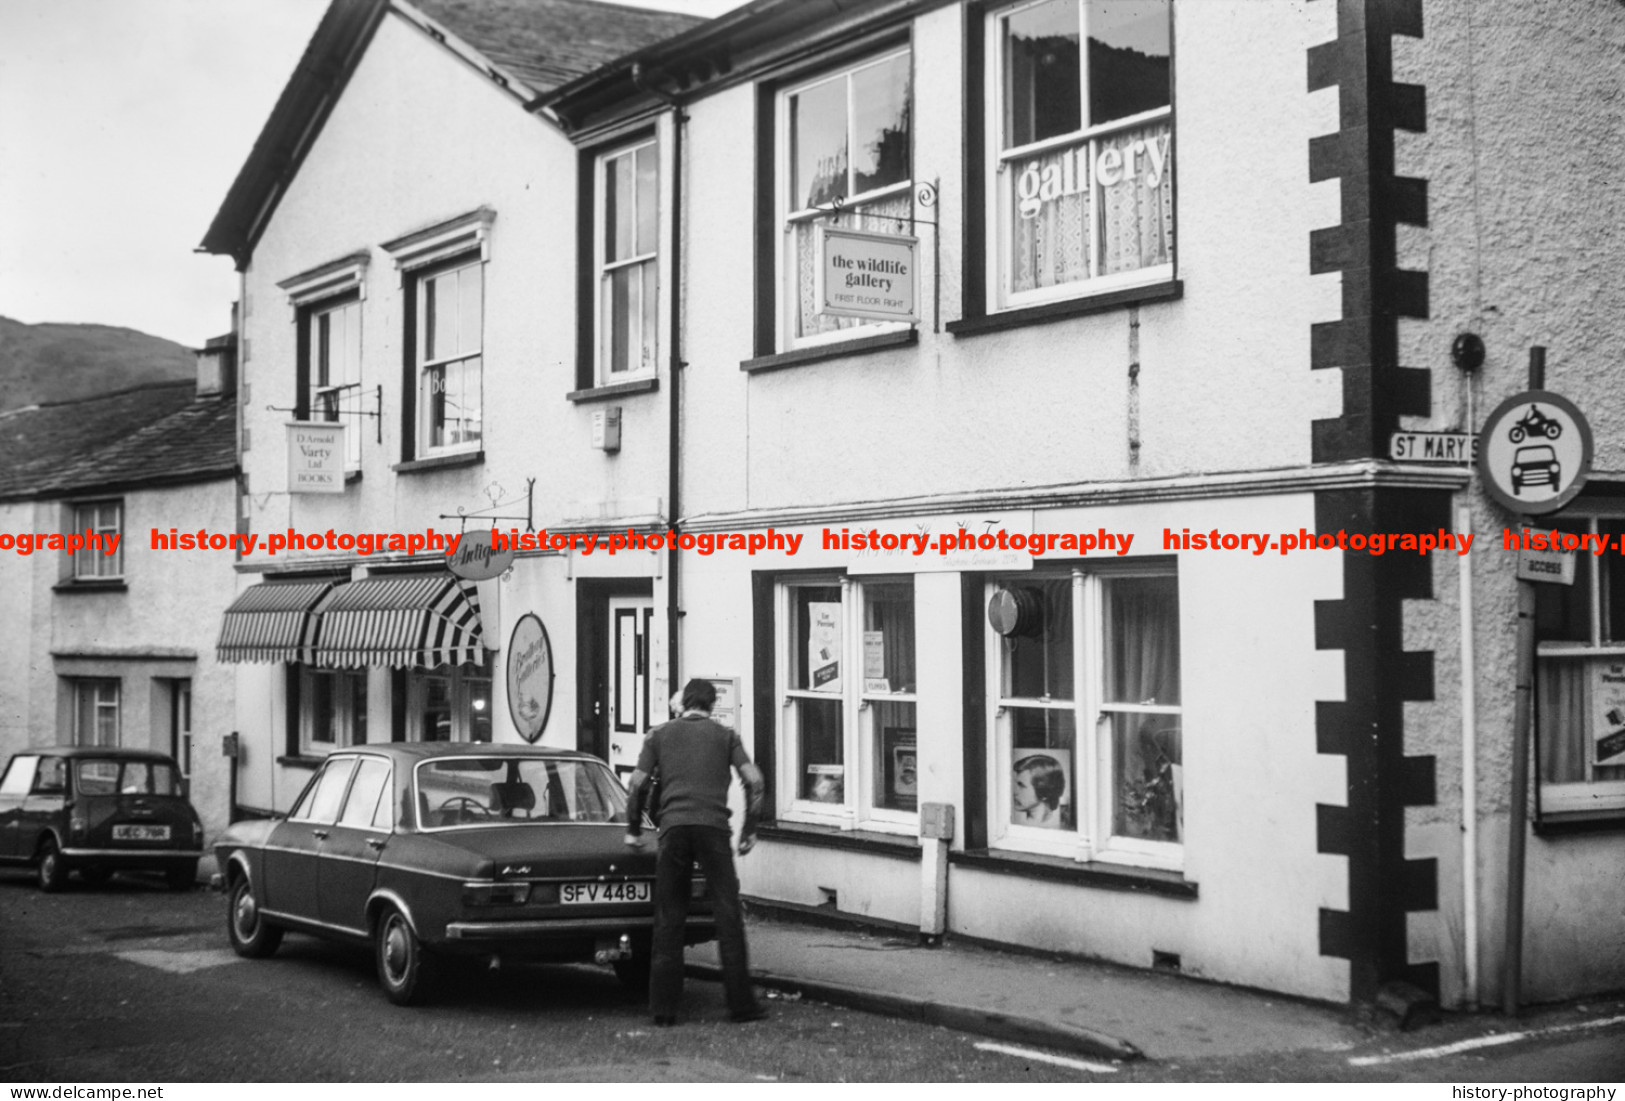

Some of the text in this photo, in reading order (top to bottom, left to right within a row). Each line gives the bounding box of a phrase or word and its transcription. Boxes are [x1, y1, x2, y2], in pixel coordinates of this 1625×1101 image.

[1019, 133, 1171, 219] gallery
[832, 254, 907, 275] the wildlife
[845, 272, 892, 293] gallery
[835, 293, 904, 308] FIRST FLOOR RIGHT
[300, 445, 332, 461] Varty
[1396, 436, 1416, 458] ST
[308, 459, 322, 469] Ltd
[297, 473, 333, 483] BOOKS
[1529, 560, 1562, 575] access
[564, 883, 648, 902] SFV 448J
